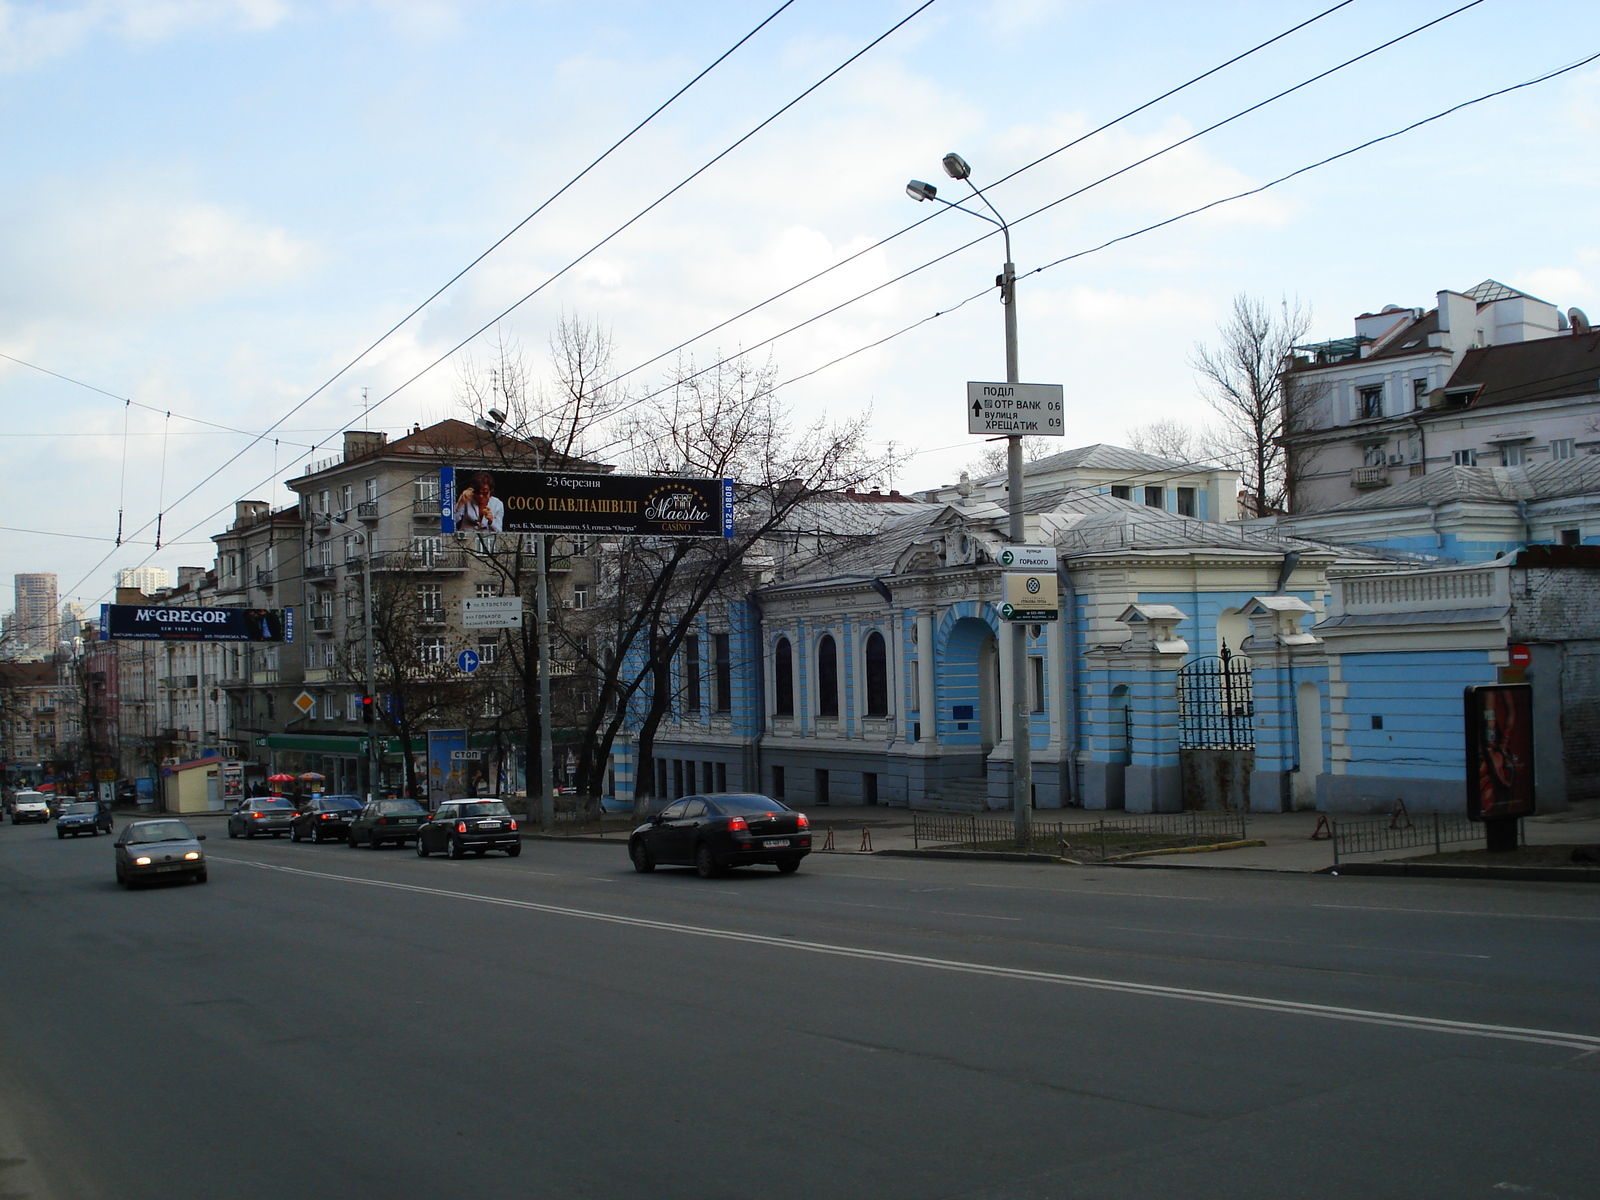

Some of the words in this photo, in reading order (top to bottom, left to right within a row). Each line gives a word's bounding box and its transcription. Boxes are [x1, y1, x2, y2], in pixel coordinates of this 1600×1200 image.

[984, 387, 1014, 397] ПОДІЛ
[994, 400, 1014, 409] OTP
[1016, 400, 1042, 410] BANK
[984, 412, 1018, 420] вулиця
[985, 421, 1039, 430] ХРЕЩАТИК
[546, 476, 559, 487] 23
[560, 477, 601, 489] березня
[443, 482, 451, 506] News
[507, 496, 544, 512] СОСО
[548, 498, 638, 514] ПАВЛІАШВІЛІ
[645, 497, 711, 522] Maestro
[725, 485, 733, 529] 482-0808
[661, 523, 691, 532] CASINO
[1019, 558, 1049, 566] ГОРЬКОГО
[135, 609, 227, 624] McGREGOR
